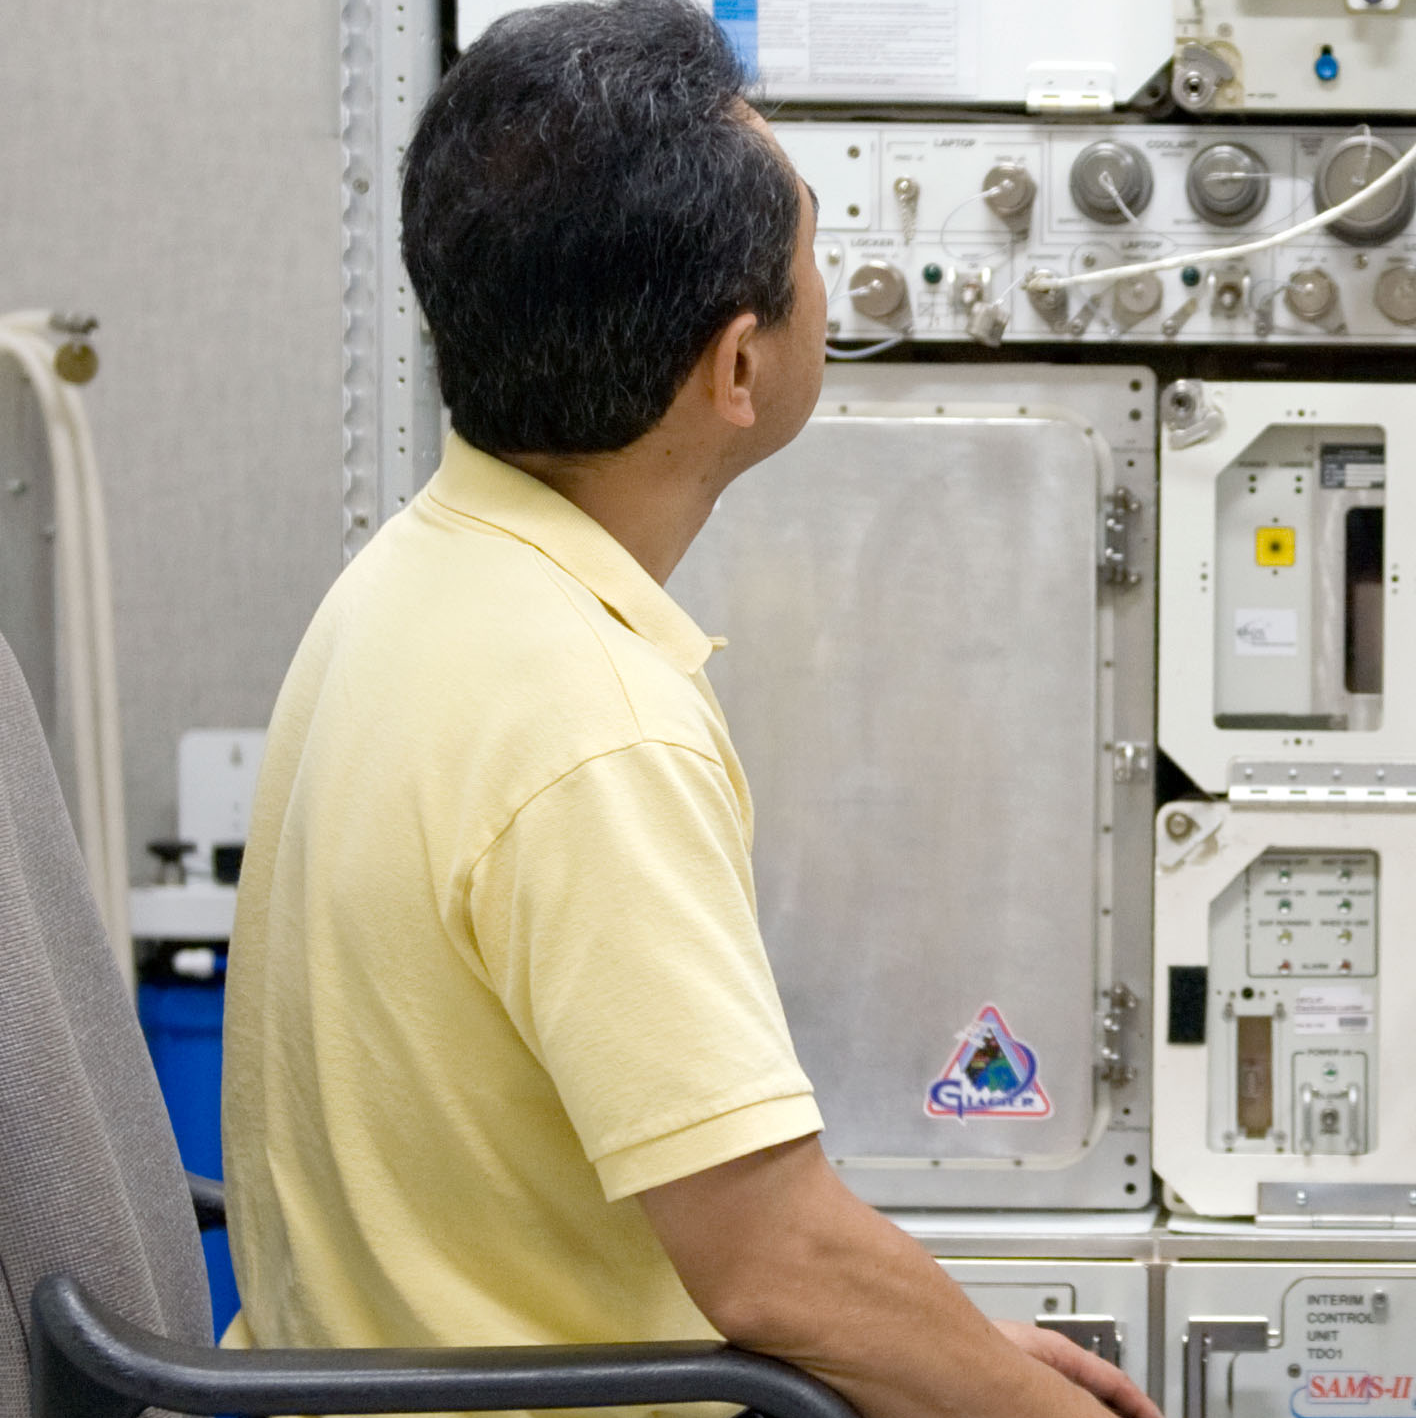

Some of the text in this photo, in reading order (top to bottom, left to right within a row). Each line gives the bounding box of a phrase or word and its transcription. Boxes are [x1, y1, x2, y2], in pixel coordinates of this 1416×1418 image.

[933, 138, 977, 148] LAPTOP
[1306, 1294, 1364, 1306] INTERIM
[1306, 1312, 1375, 1324] CONTROL
[1306, 1330, 1340, 1342] UNIT
[1309, 1374, 1414, 1400] SAMS-II
